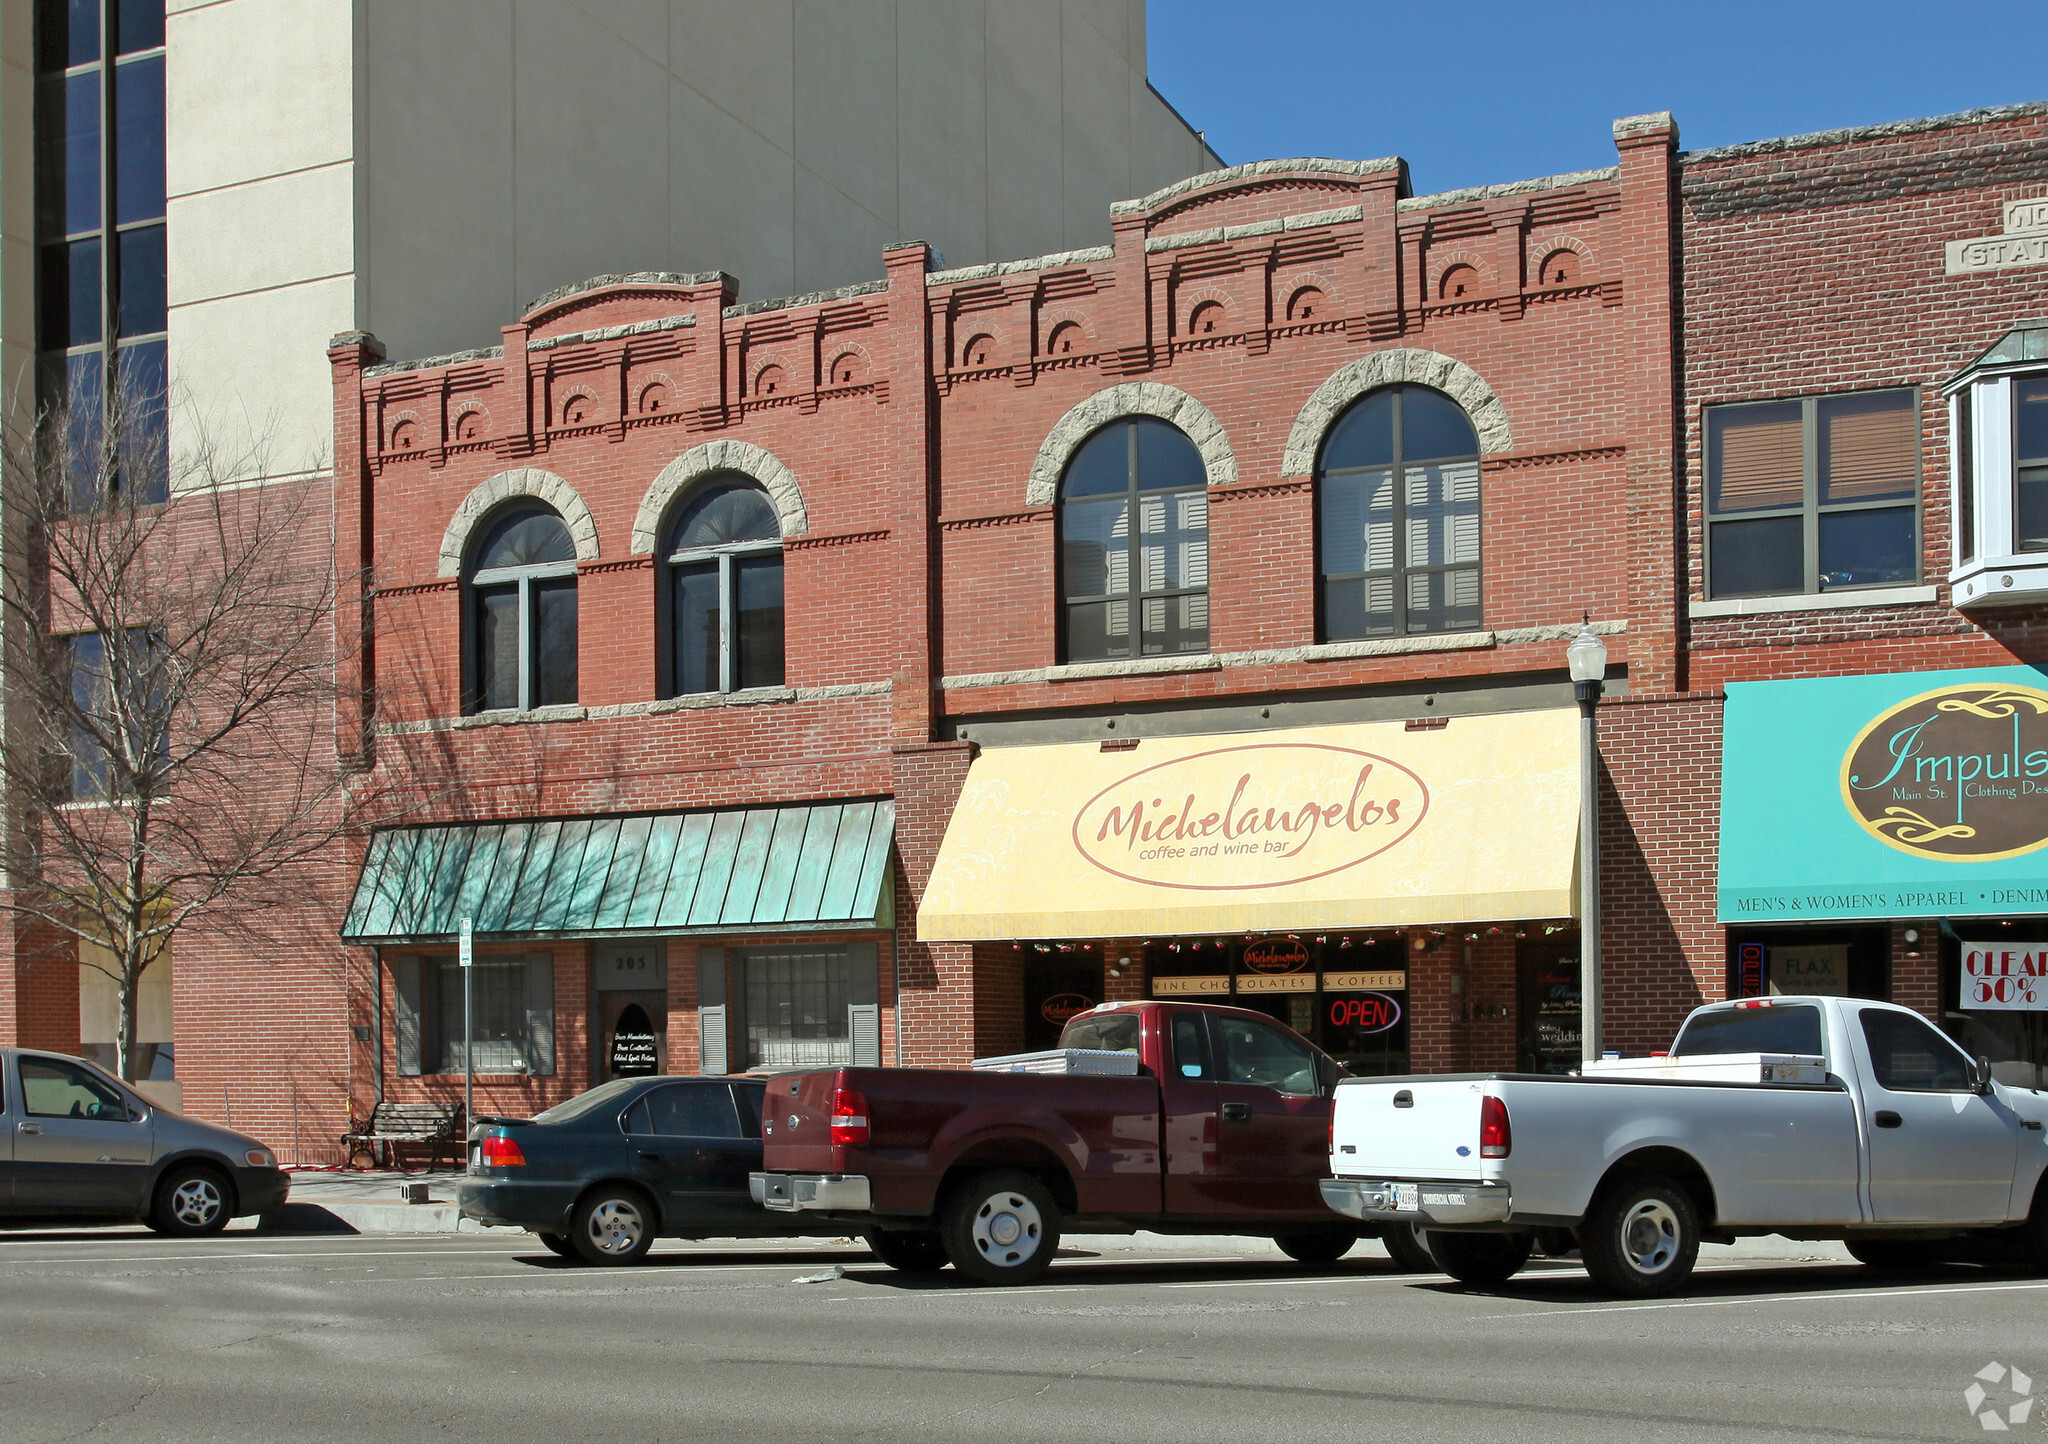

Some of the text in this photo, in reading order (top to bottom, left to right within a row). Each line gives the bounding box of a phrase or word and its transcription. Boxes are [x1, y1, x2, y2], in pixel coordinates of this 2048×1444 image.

[1892, 787, 1922, 801] Main
[1926, 785, 1948, 799] St.
[1965, 782, 2017, 799] Clothing
[1097, 763, 1400, 858] Michelangelos
[1139, 840, 1289, 860] coffee and wine bar
[1737, 889, 2048, 912] MEN'S & WOMEN'S APPAREL DENIM
[615, 956, 645, 970] 205
[1785, 959, 1831, 975] FLAX
[1337, 975, 1402, 986] COFFEES
[1972, 977, 2037, 1004] 50%
[1331, 1001, 1389, 1026] OPEN
